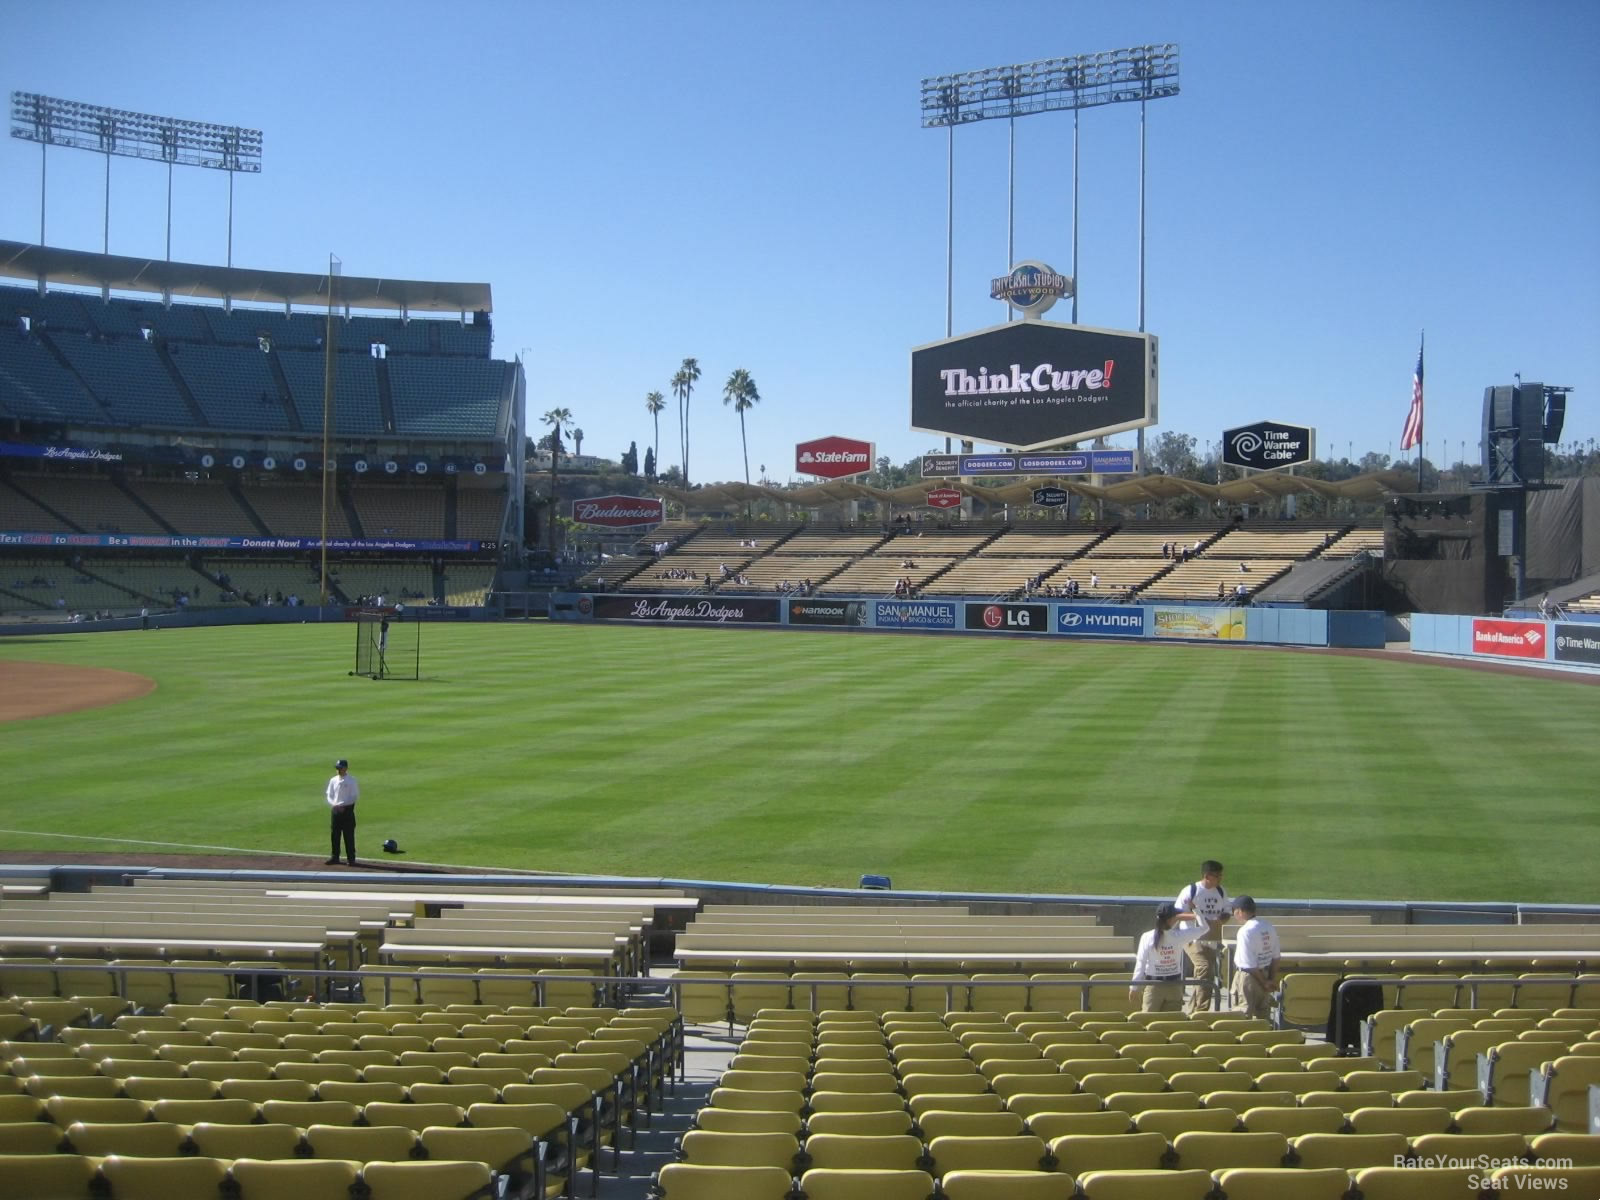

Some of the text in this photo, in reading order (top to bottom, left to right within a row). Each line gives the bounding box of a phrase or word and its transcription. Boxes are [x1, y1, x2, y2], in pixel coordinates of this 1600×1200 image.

[991, 272, 1064, 293] UNIVERSAL STUDIOS
[1000, 288, 1054, 297] HOLLYWOOD
[940, 360, 1114, 396] ThinkCure!
[984, 399, 1008, 408] charity
[1046, 396, 1075, 405] Angeles
[1077, 395, 1109, 403] Dodgers
[1263, 431, 1289, 440] Time
[1263, 441, 1300, 450] Warner
[59, 447, 89, 460] Angeles
[89, 449, 122, 461] Dodgers
[1263, 450, 1293, 460] Cable
[576, 503, 660, 520] Budweiser
[0, 533, 21, 543] Text
[55, 535, 66, 544] to
[108, 536, 121, 545] Be
[171, 538, 180, 546] in
[182, 537, 197, 546] the
[242, 539, 300, 548] Donate Now!
[481, 541, 496, 549] 4:25
[630, 600, 744, 622] Los Angeles Dodgers
[878, 605, 953, 617] SAN MANUEL
[1007, 610, 1030, 626] LG
[1085, 614, 1142, 627] HYUNDAI
[1475, 631, 1524, 645] Bank of America
[1565, 636, 1583, 649] Time
